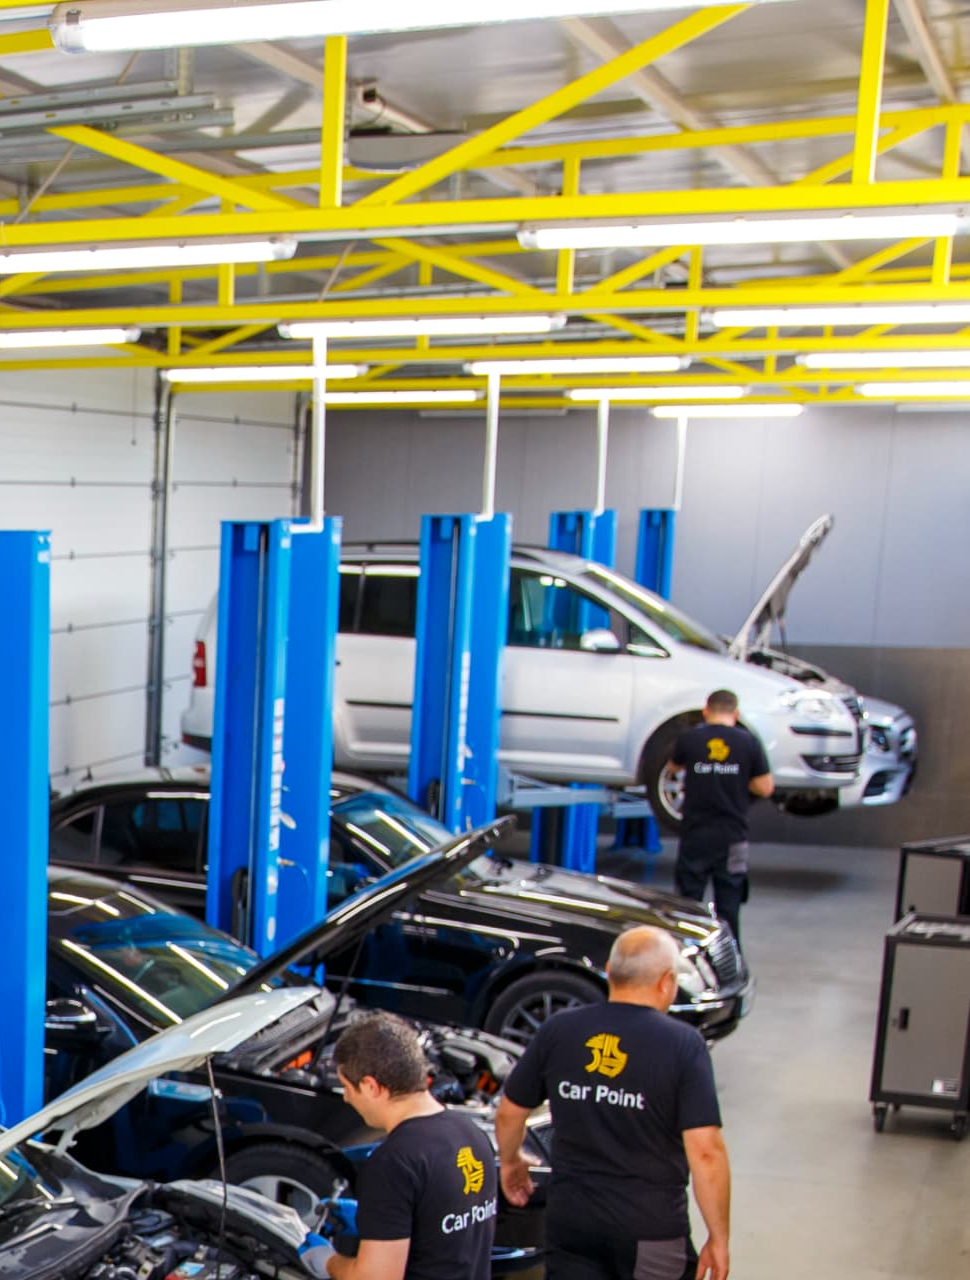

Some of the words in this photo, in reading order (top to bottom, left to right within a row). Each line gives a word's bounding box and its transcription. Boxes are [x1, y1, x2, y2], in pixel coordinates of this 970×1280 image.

[693, 761, 712, 774] Car
[558, 1081, 591, 1101] Car
[595, 1084, 646, 1110] Point
[441, 1212, 470, 1235] Car
